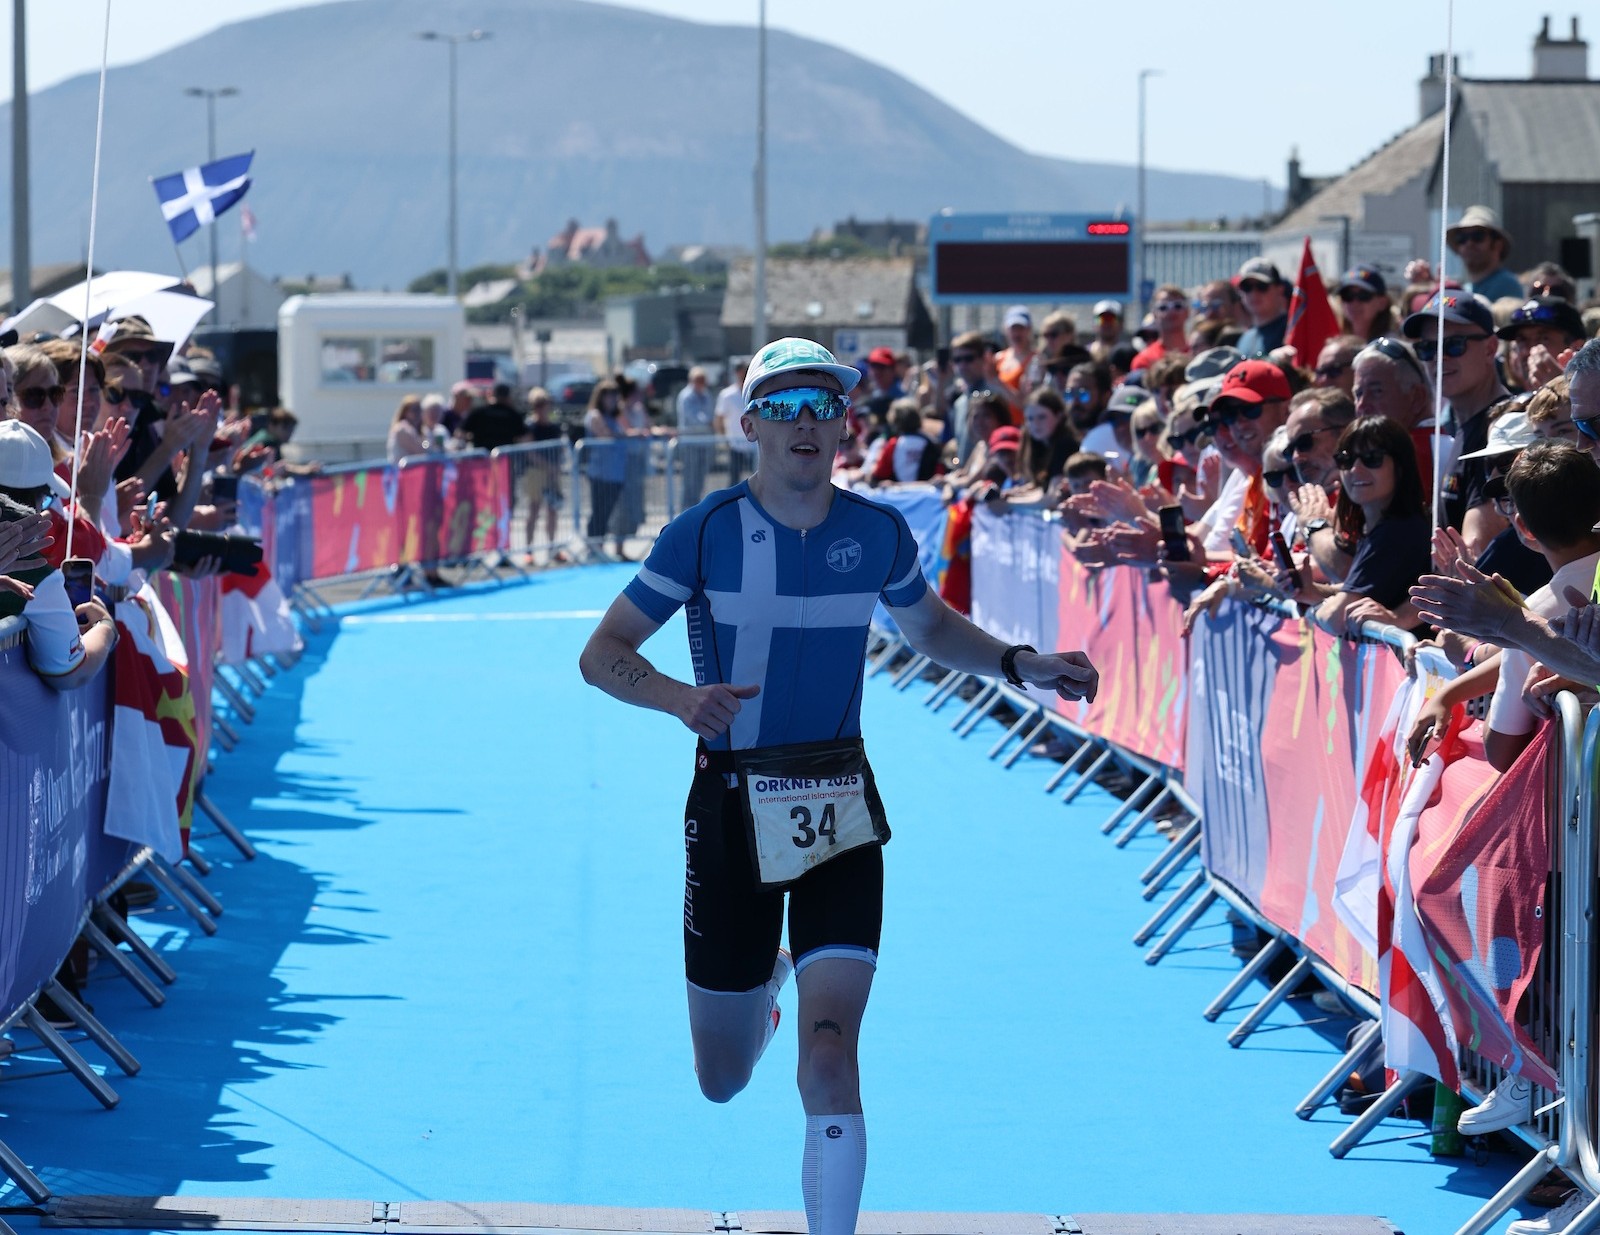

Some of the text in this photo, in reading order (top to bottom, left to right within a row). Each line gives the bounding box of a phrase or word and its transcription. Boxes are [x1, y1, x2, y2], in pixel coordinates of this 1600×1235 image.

[686, 605, 705, 685] etland
[755, 774, 858, 793] ORKNEY 2025
[758, 793, 811, 805] International
[790, 803, 837, 849] 34
